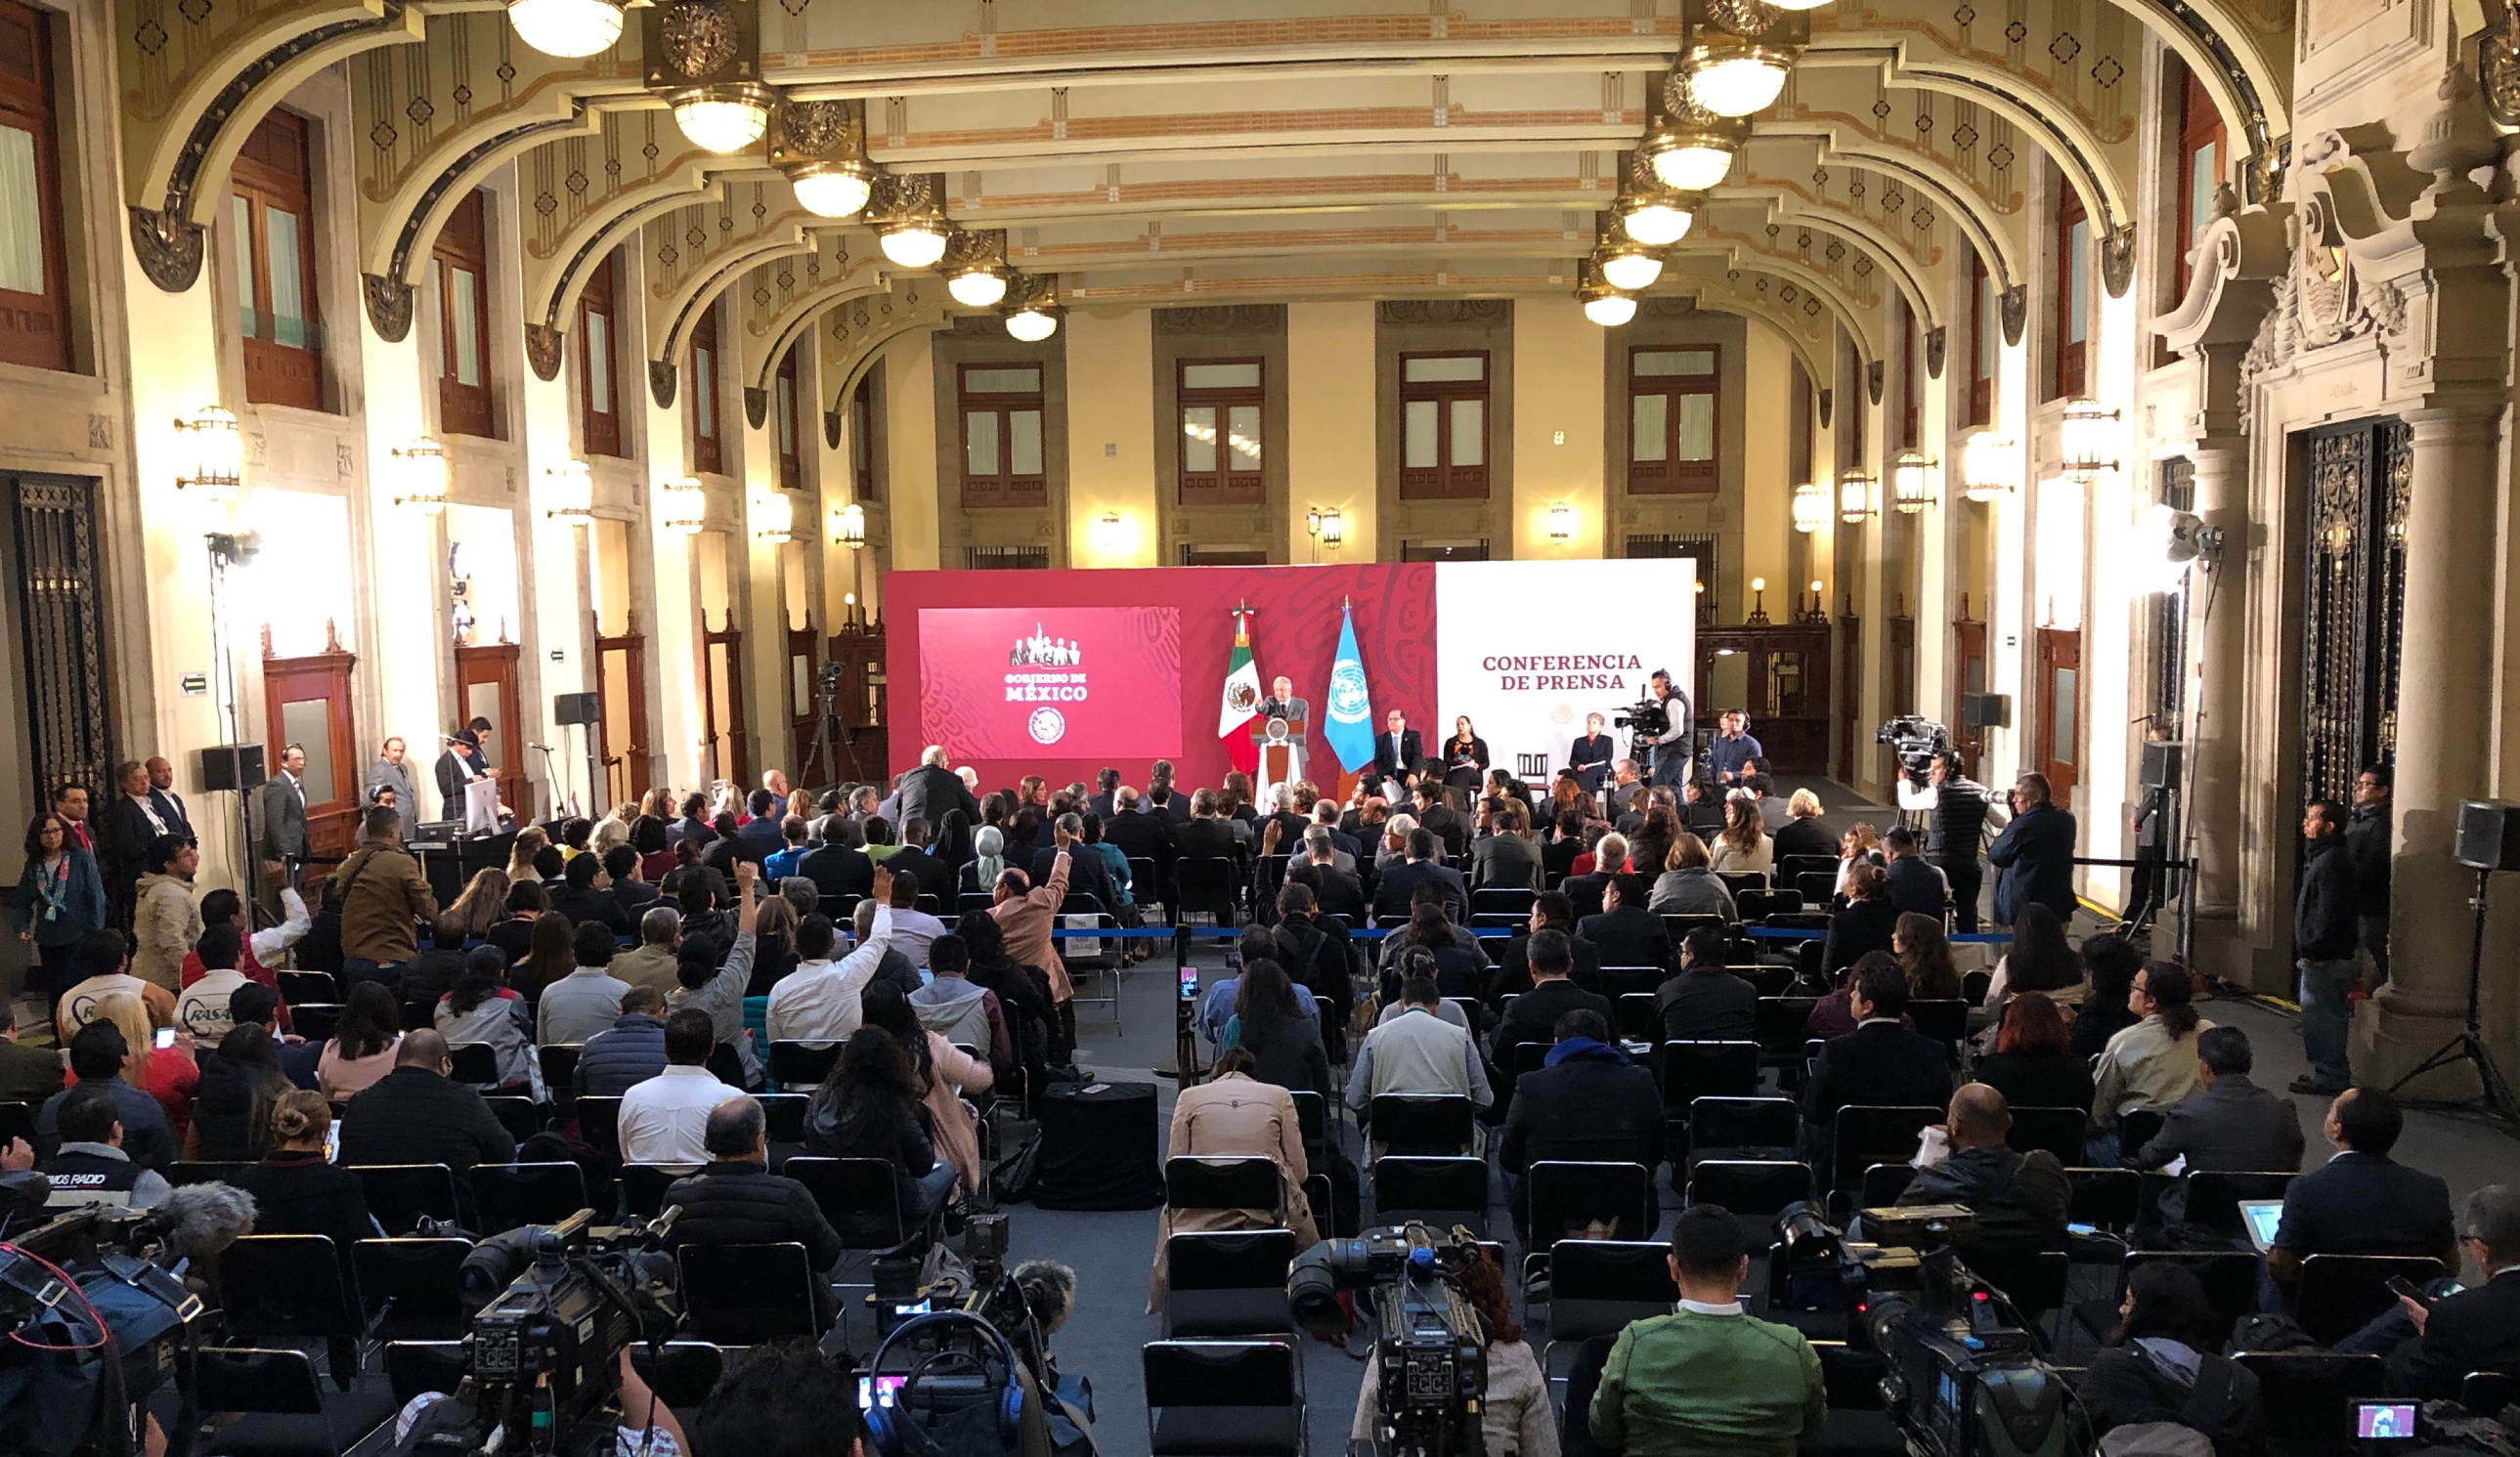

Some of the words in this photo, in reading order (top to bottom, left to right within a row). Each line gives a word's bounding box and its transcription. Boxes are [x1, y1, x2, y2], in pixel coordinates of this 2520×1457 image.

[1482, 654, 1643, 671] CONFERENCIA
[1004, 673, 1069, 684] GOBIERNO
[1069, 673, 1087, 684] DE
[1500, 675, 1530, 690] DE
[1536, 674, 1626, 690] PRENSA
[1005, 683, 1088, 702] MÉXICO
[46, 1174, 70, 1185] MOS
[70, 1174, 106, 1185] RADIO
